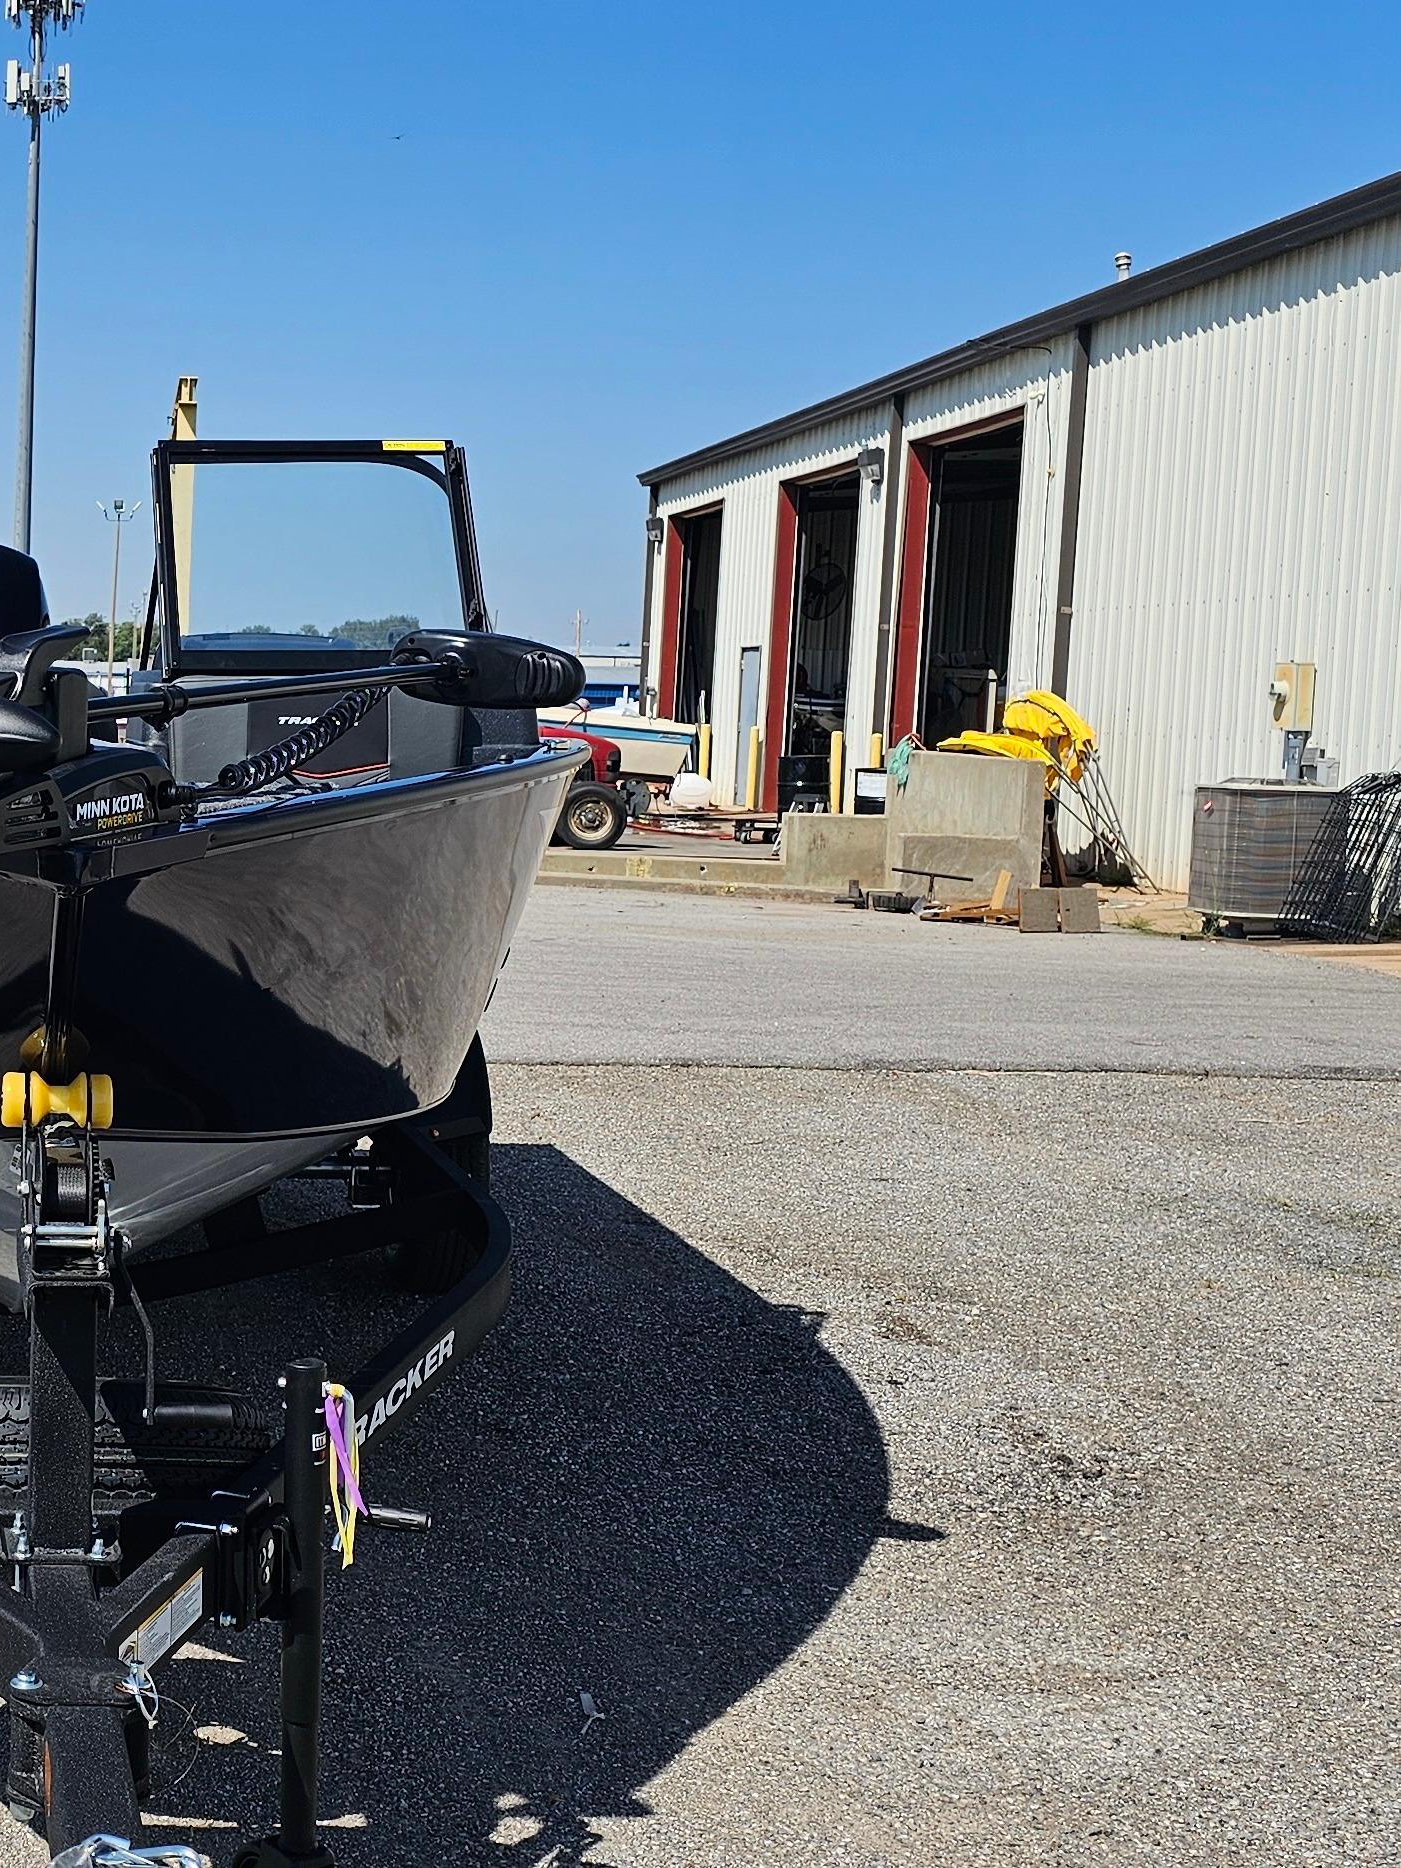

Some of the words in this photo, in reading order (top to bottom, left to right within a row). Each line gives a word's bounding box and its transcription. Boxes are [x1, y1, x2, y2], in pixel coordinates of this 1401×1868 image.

[76, 799, 111, 821] MINN
[112, 792, 145, 815] KOTA
[97, 810, 144, 831] POWERDRIVE
[354, 1328, 456, 1447] RACKER
